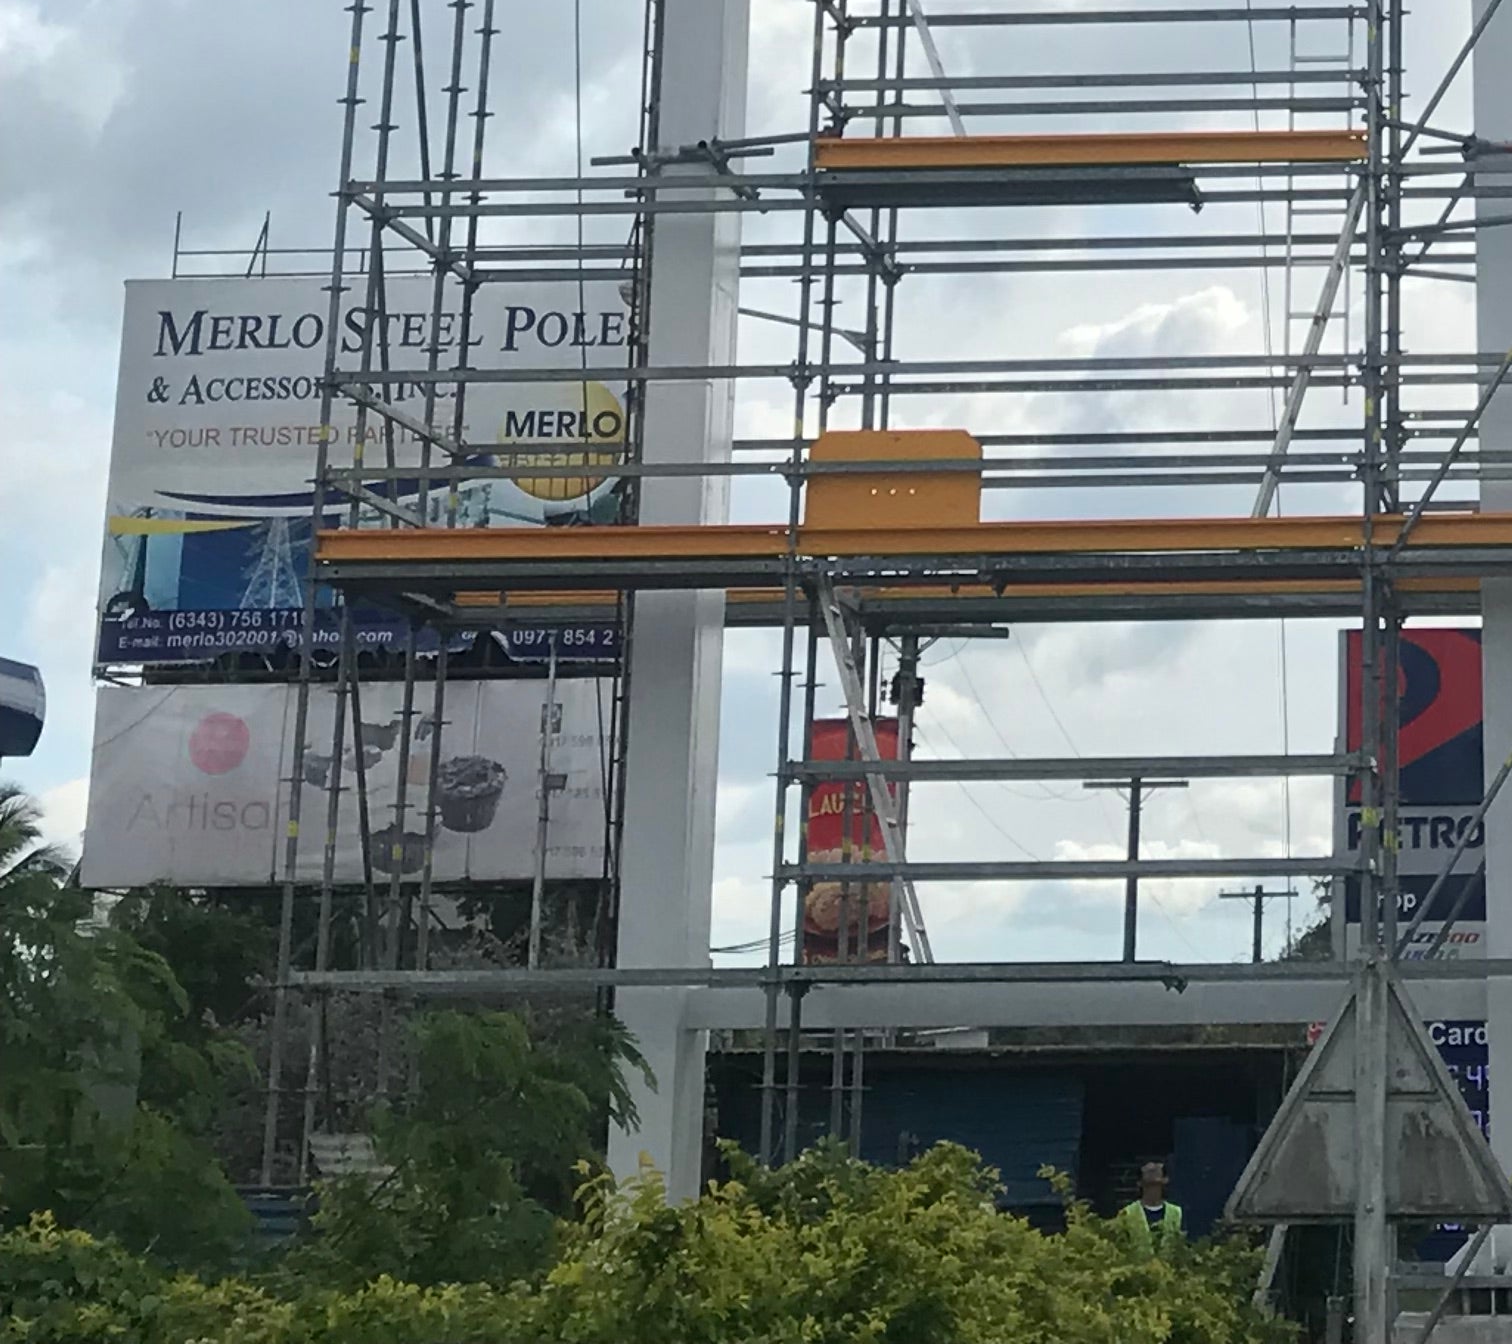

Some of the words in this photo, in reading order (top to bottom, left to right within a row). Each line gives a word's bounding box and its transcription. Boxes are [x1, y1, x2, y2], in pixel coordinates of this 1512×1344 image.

[153, 309, 324, 357] MERLO
[147, 376, 170, 403] &
[230, 426, 338, 445] TRUSTED
[505, 410, 622, 439] MERLO
[169, 612, 225, 630] (6343)
[230, 612, 262, 627] 756
[563, 629, 596, 645] 854
